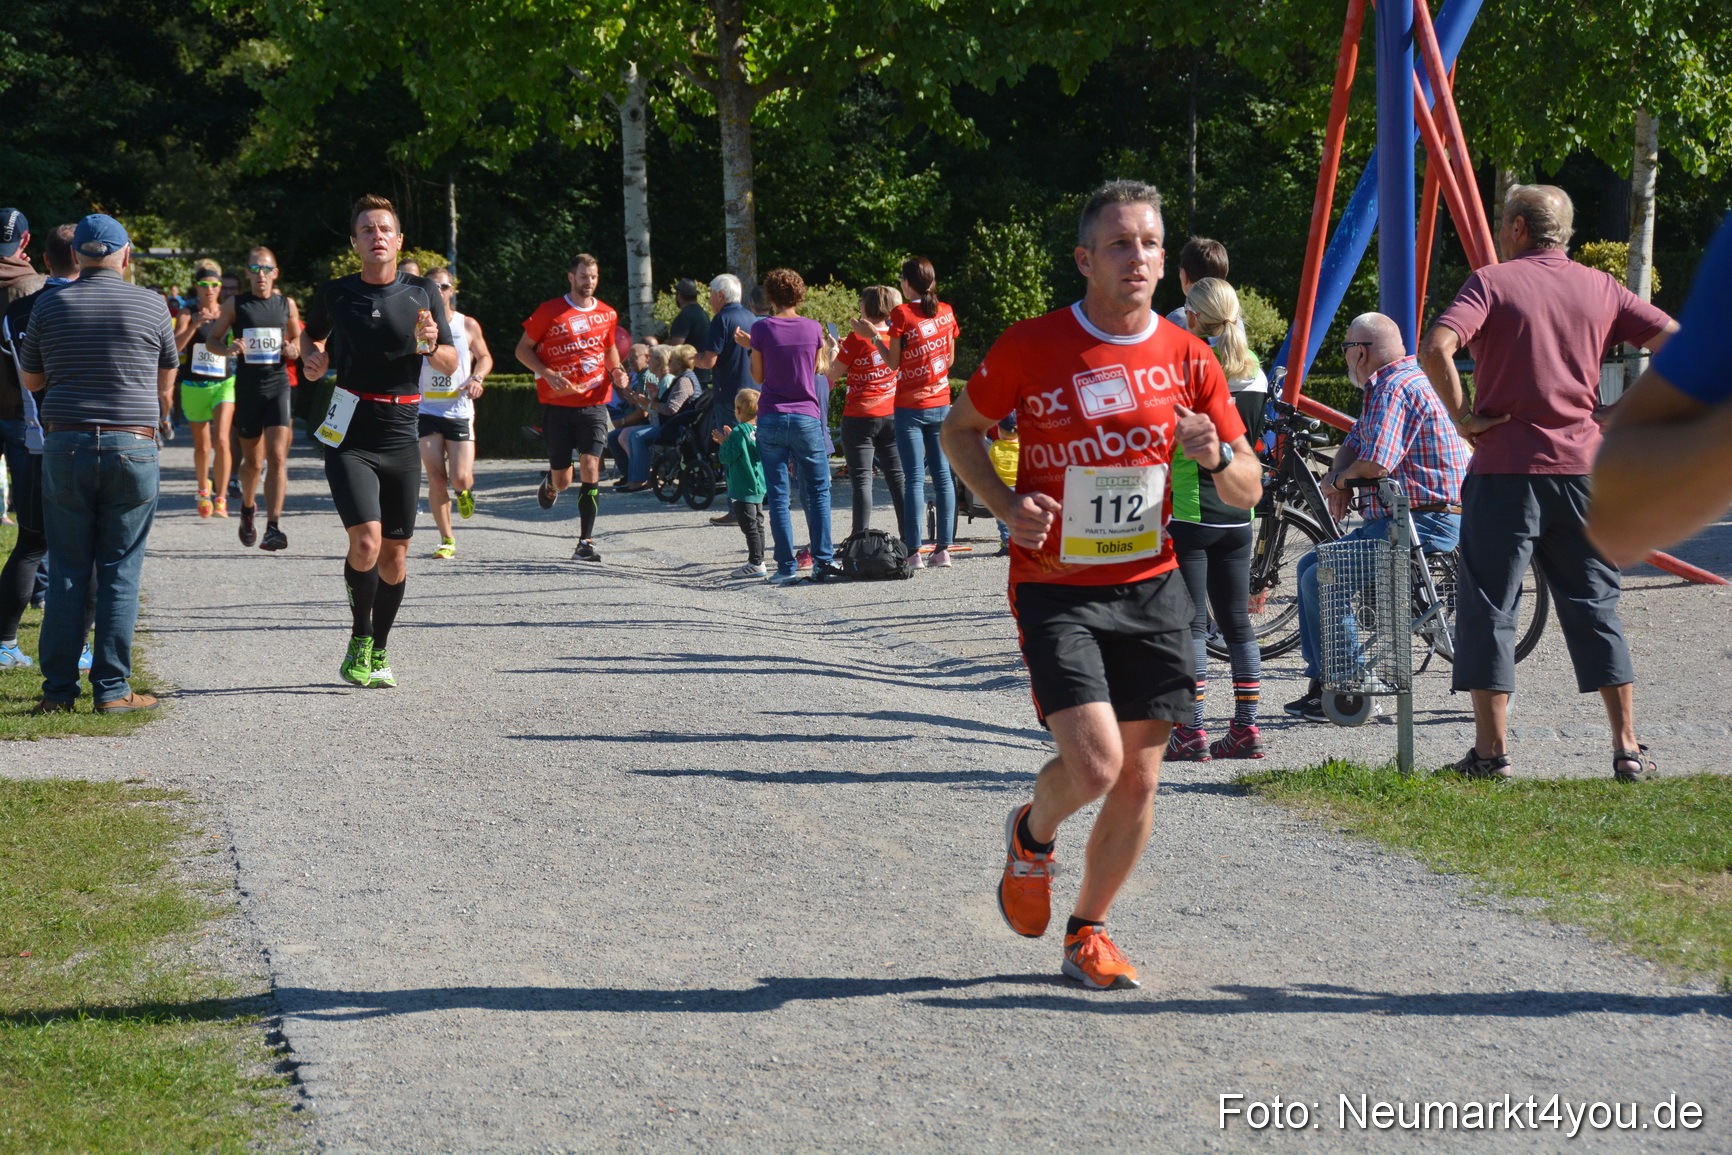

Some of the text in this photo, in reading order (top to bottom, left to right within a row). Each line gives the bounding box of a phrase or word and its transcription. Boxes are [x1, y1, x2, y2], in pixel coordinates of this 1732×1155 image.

[249, 338, 276, 349] 2160
[547, 335, 605, 357] raumbox
[431, 376, 452, 387] 328
[1077, 369, 1124, 386] raumbox
[1024, 422, 1169, 470] raumbox
[1095, 476, 1141, 487] BOCK
[1091, 494, 1143, 524] 112
[1108, 527, 1137, 535] Neumarkt
[1095, 541, 1133, 553] Tobias
